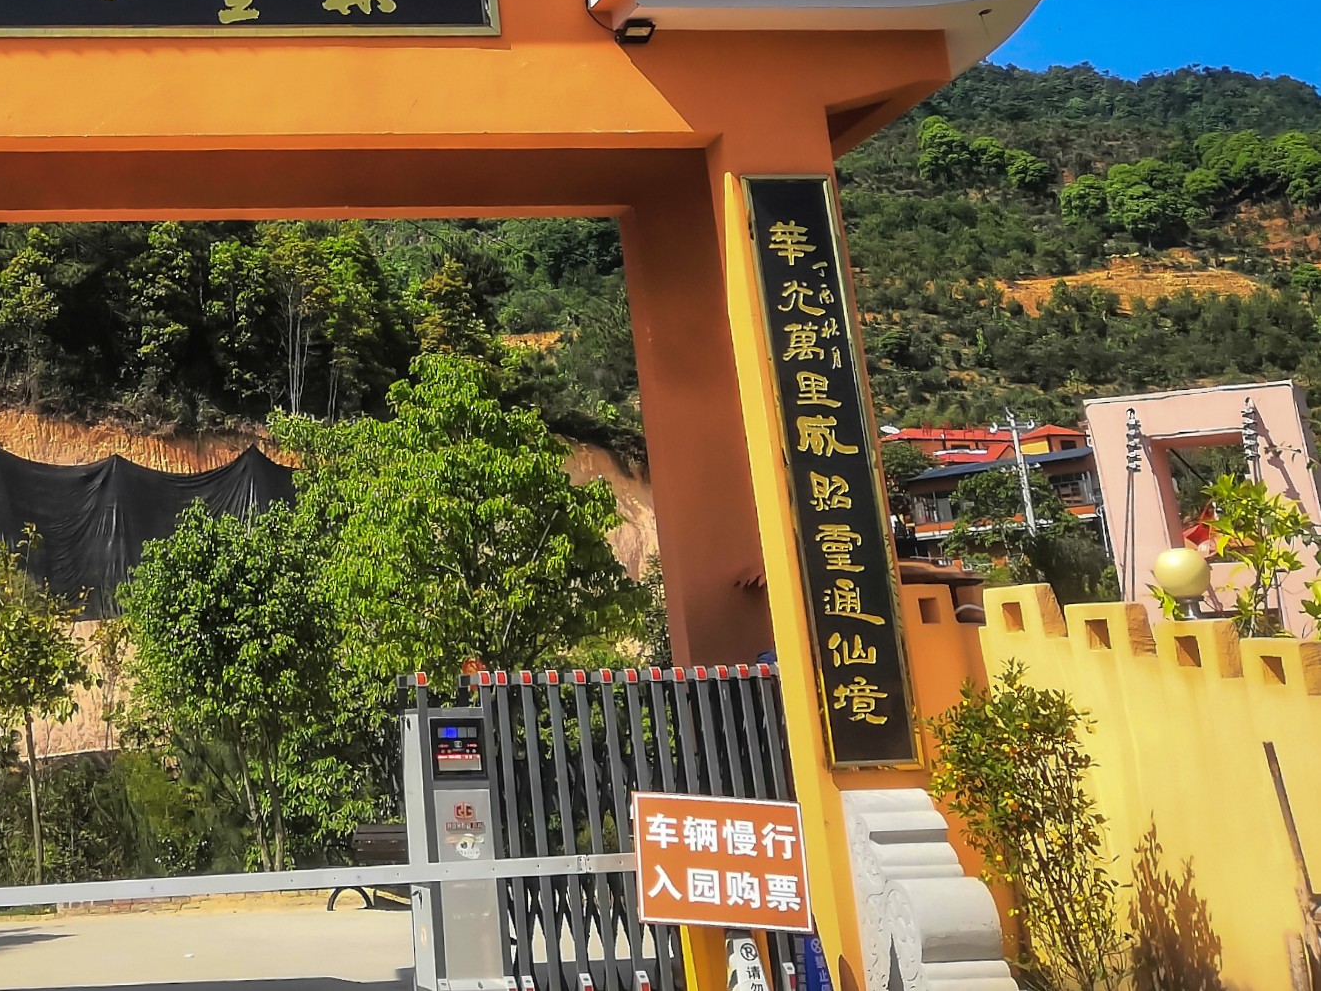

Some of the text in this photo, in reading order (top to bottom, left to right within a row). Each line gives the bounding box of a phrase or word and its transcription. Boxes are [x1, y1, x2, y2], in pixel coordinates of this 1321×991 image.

[645, 813, 797, 860] 车辆慢行
[647, 865, 803, 913] 入园购票
